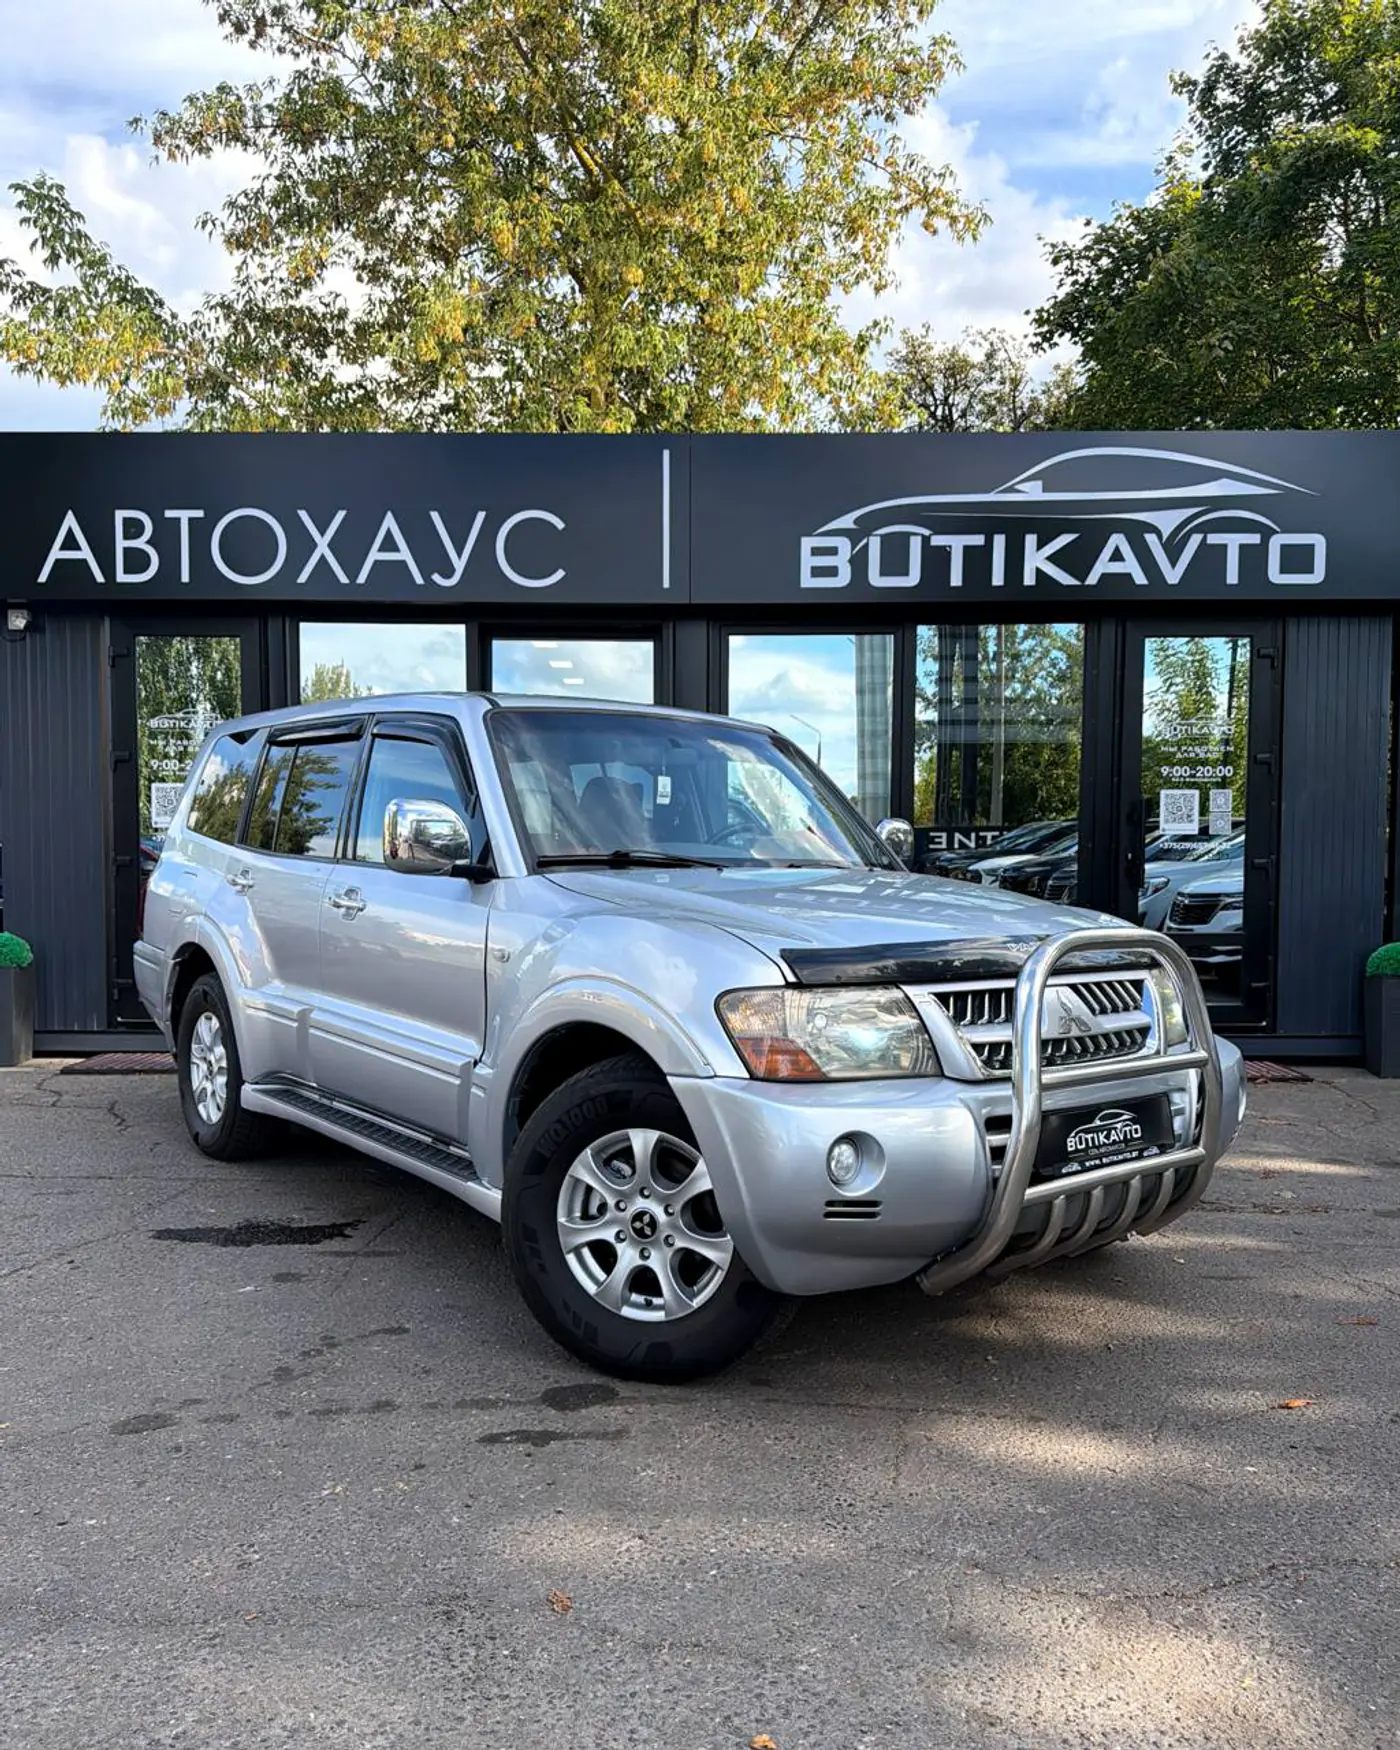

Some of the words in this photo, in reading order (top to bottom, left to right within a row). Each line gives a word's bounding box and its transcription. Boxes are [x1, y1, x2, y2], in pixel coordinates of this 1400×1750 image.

[38, 508, 566, 588] АВТОХАУС
[800, 532, 1327, 588] BUTIKAVTO
[1160, 766, 1234, 777] 9:00-20:00
[1066, 1124, 1142, 1152] BUTIKAVTO
